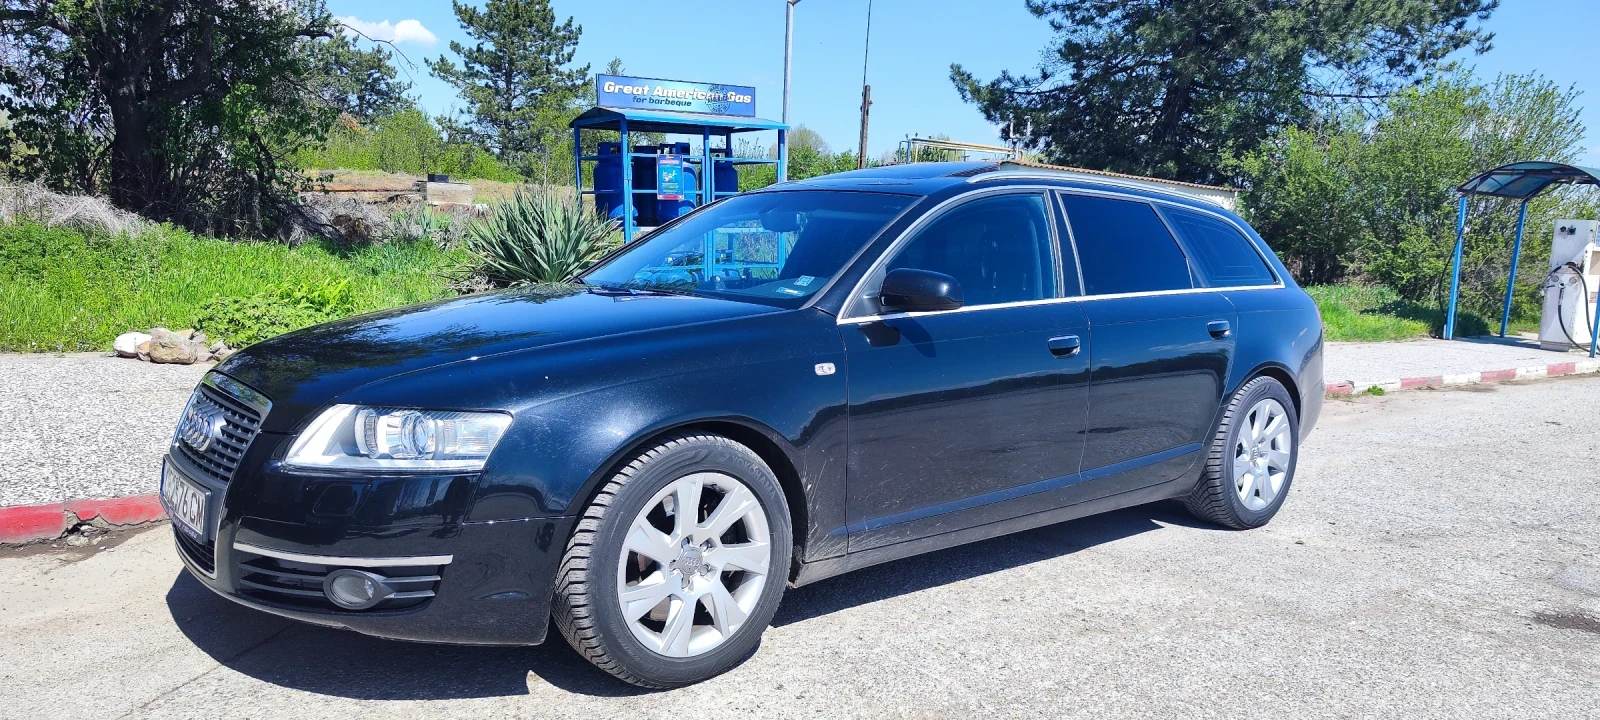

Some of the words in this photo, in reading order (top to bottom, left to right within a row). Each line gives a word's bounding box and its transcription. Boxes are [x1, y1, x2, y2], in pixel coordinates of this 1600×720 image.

[603, 81, 650, 95] Great
[652, 85, 724, 101] American
[727, 91, 752, 103] Gas
[632, 95, 647, 103] for
[648, 97, 692, 107] barbeque
[732, 455, 776, 500] YOKOHAMA
